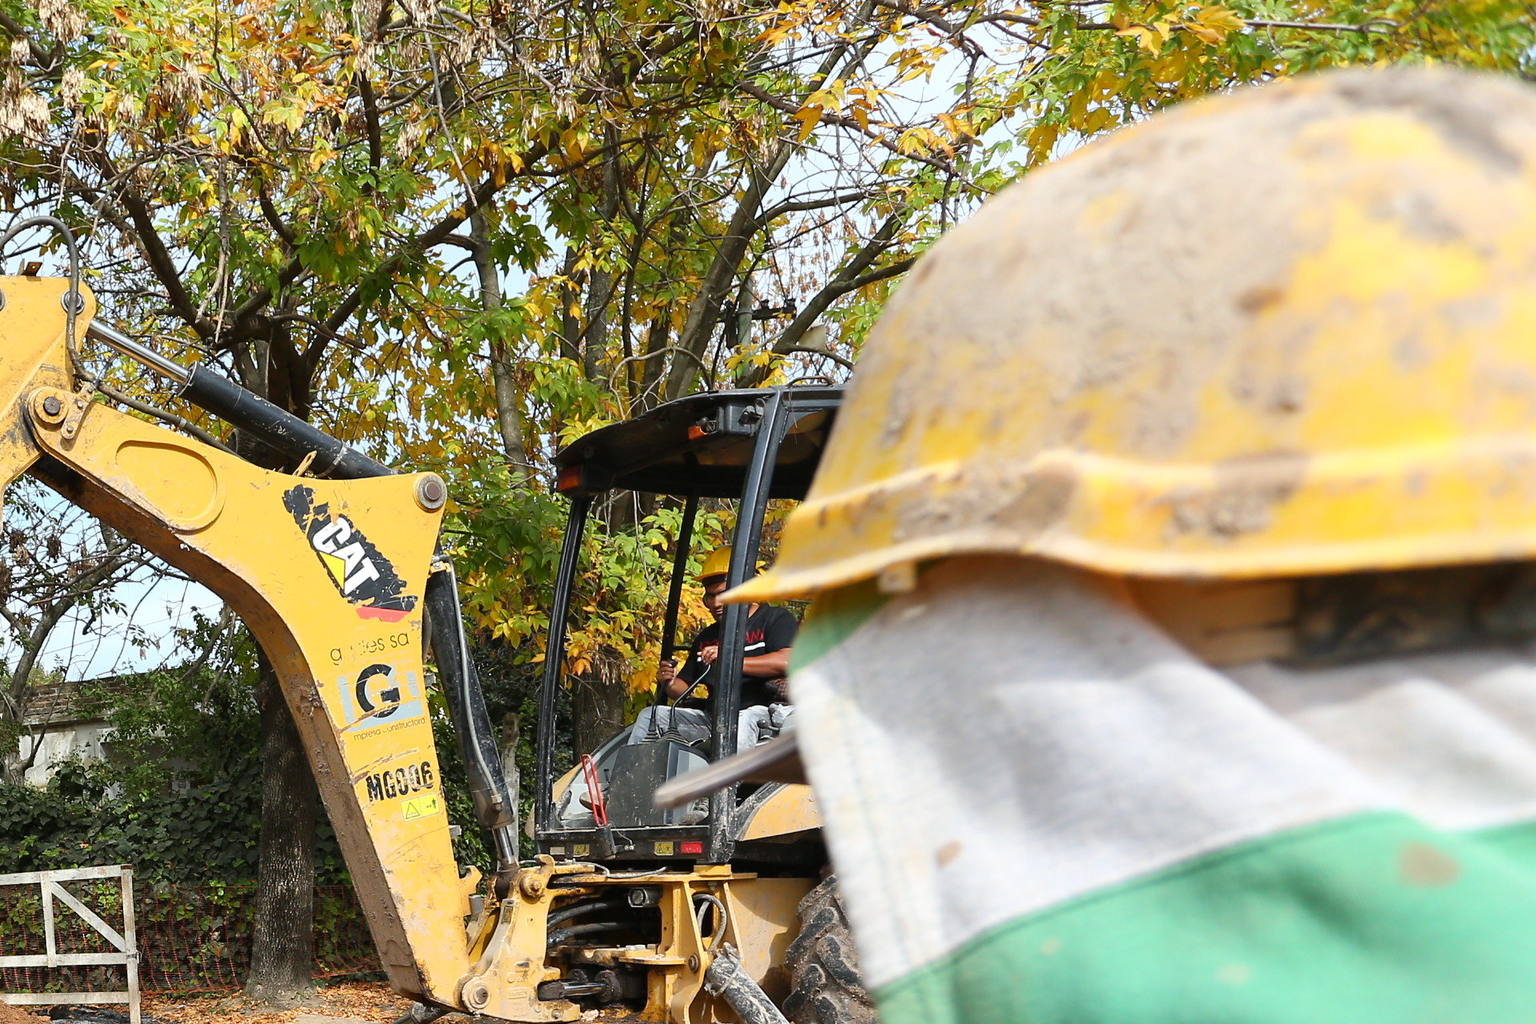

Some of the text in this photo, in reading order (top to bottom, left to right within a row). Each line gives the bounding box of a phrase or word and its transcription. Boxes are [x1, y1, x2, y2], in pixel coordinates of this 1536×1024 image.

[312, 516, 381, 596] CAT
[389, 632, 410, 649] sa
[355, 663, 401, 719] G
[365, 761, 434, 802] MG006
